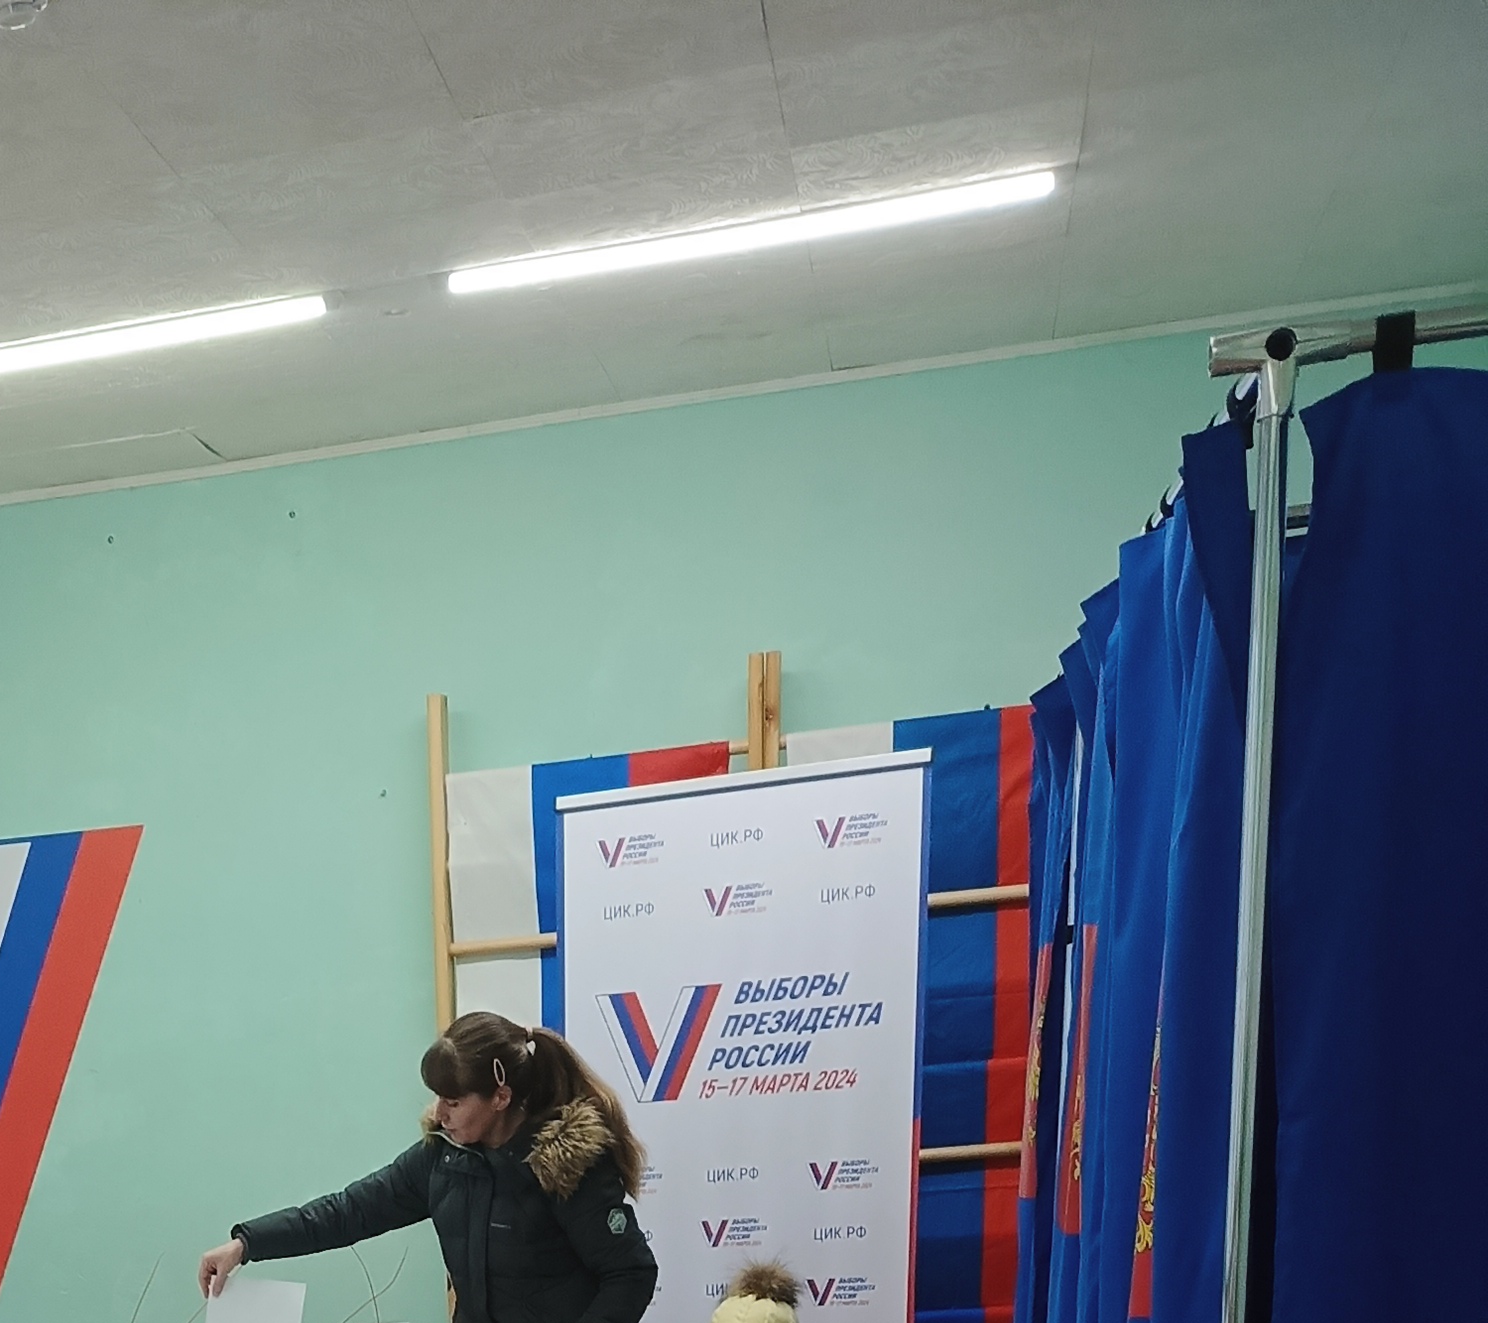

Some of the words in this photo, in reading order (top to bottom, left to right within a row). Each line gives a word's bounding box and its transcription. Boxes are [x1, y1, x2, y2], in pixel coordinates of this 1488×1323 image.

[710, 828, 763, 849] ЦИК.РФ
[820, 883, 876, 905] ЦИК.РФ
[603, 902, 655, 921] ЦИК.РФ
[734, 971, 850, 1005] ВЫБОРЫ
[720, 1001, 883, 1038] ПРЕЗИДЕНТА
[707, 1040, 811, 1071] РОССИИ
[749, 1072, 810, 1096] МАРТА
[813, 1067, 858, 1091] 2024
[707, 1167, 759, 1184] ЦИК.РФ
[813, 1225, 867, 1243] ЦИК.РФ
